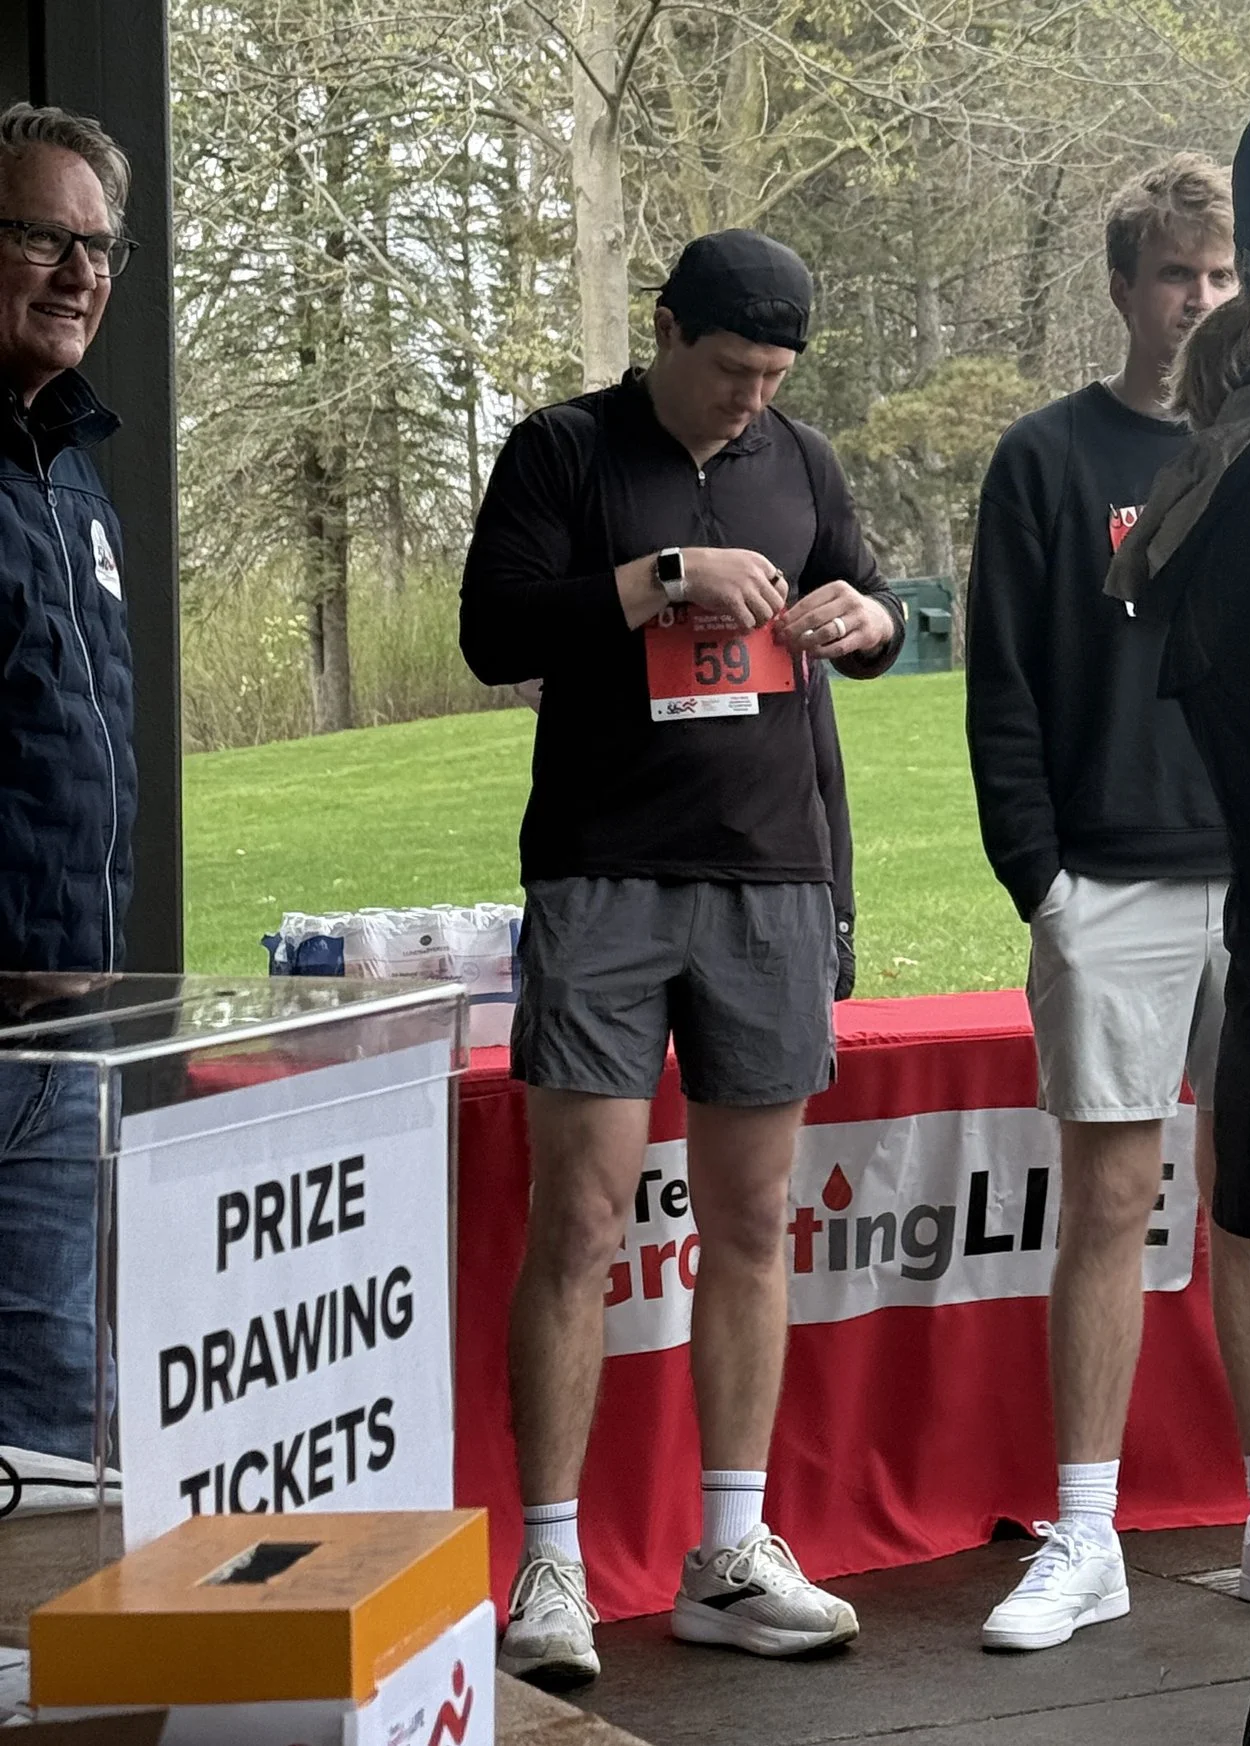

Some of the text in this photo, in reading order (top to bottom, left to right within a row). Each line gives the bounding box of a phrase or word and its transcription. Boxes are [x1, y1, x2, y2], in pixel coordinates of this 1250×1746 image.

[694, 639, 750, 685] 59
[217, 1154, 365, 1273] PRIZE
[634, 1169, 689, 1224] Te
[159, 1265, 414, 1429] DRAWING
[180, 1397, 396, 1517] TICKETS
